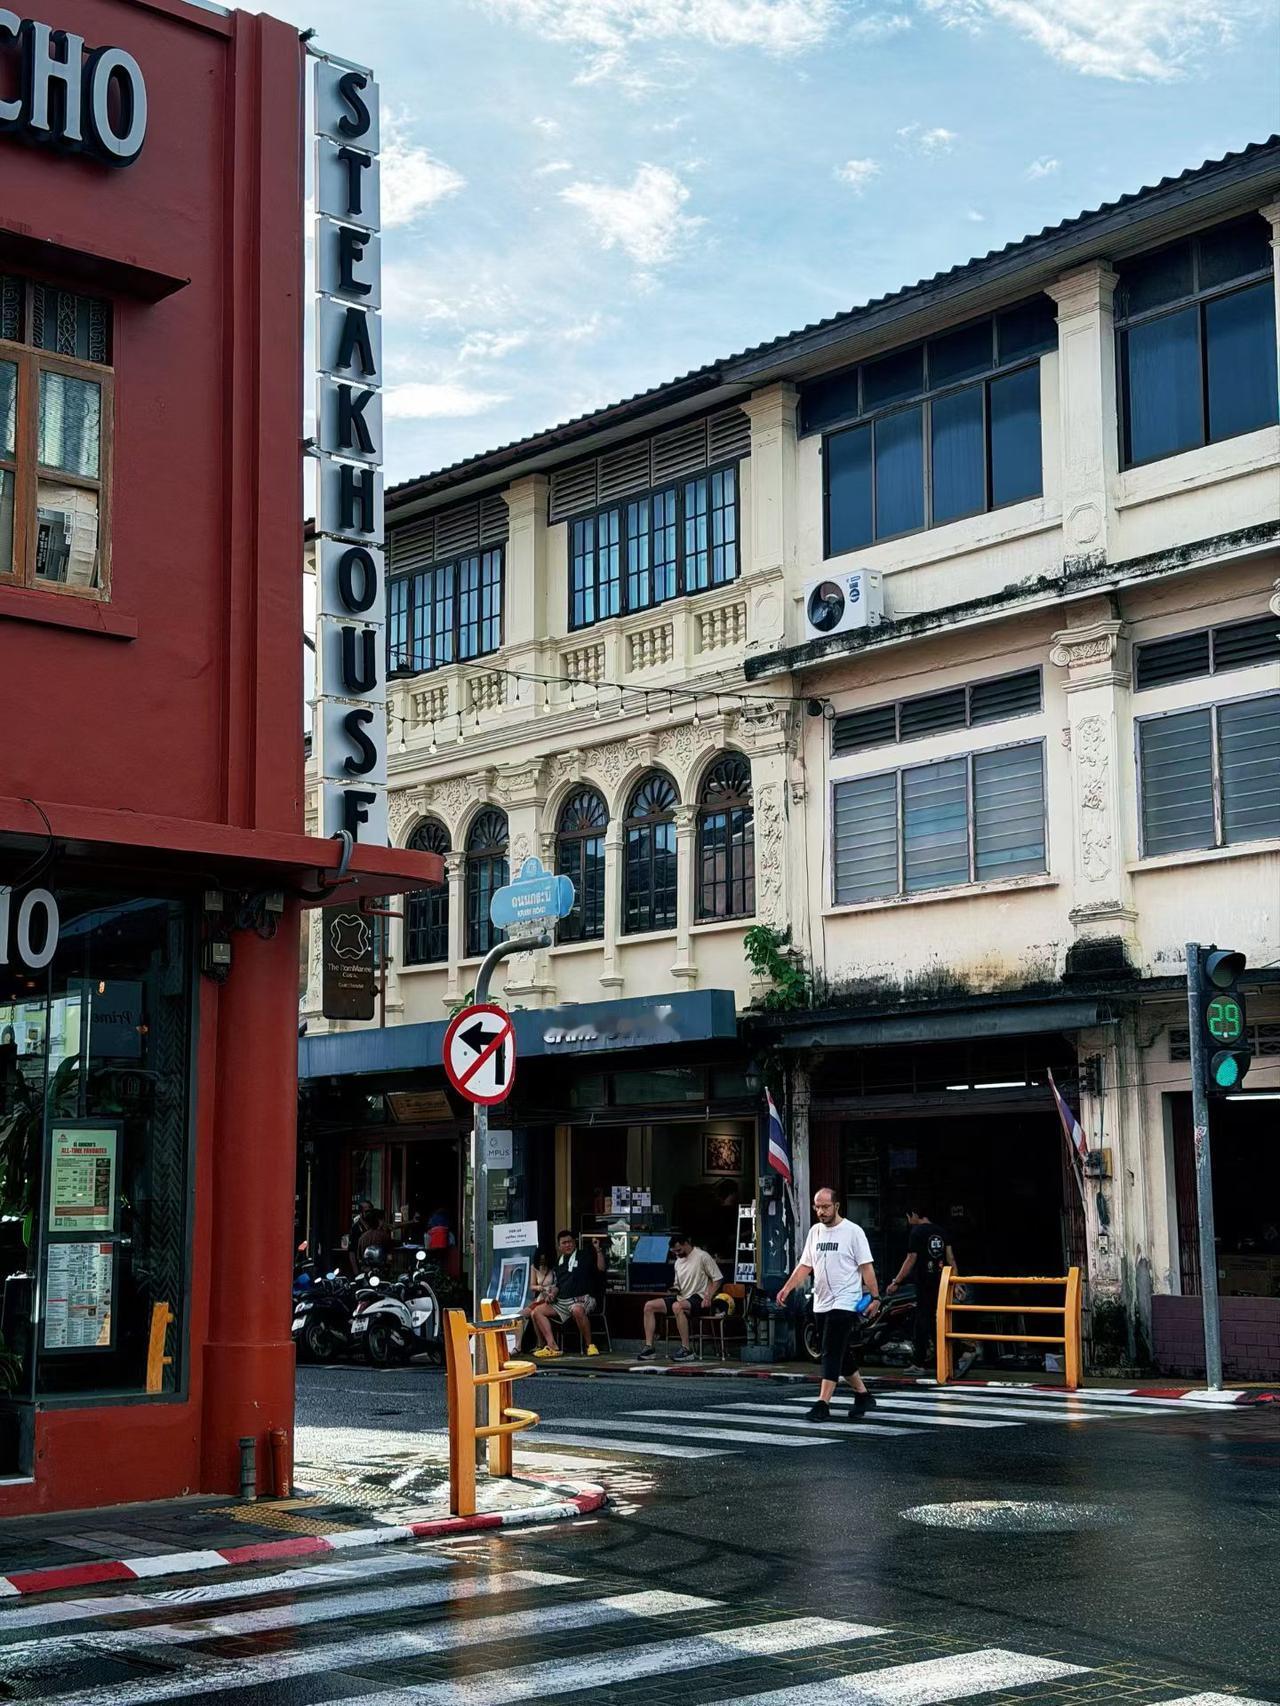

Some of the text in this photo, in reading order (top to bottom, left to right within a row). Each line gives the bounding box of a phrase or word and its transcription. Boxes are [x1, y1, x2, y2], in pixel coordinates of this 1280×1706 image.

[327, 962, 339, 972] The
[1209, 1003, 1240, 1036] 29
[816, 1242, 839, 1252] PUMA
